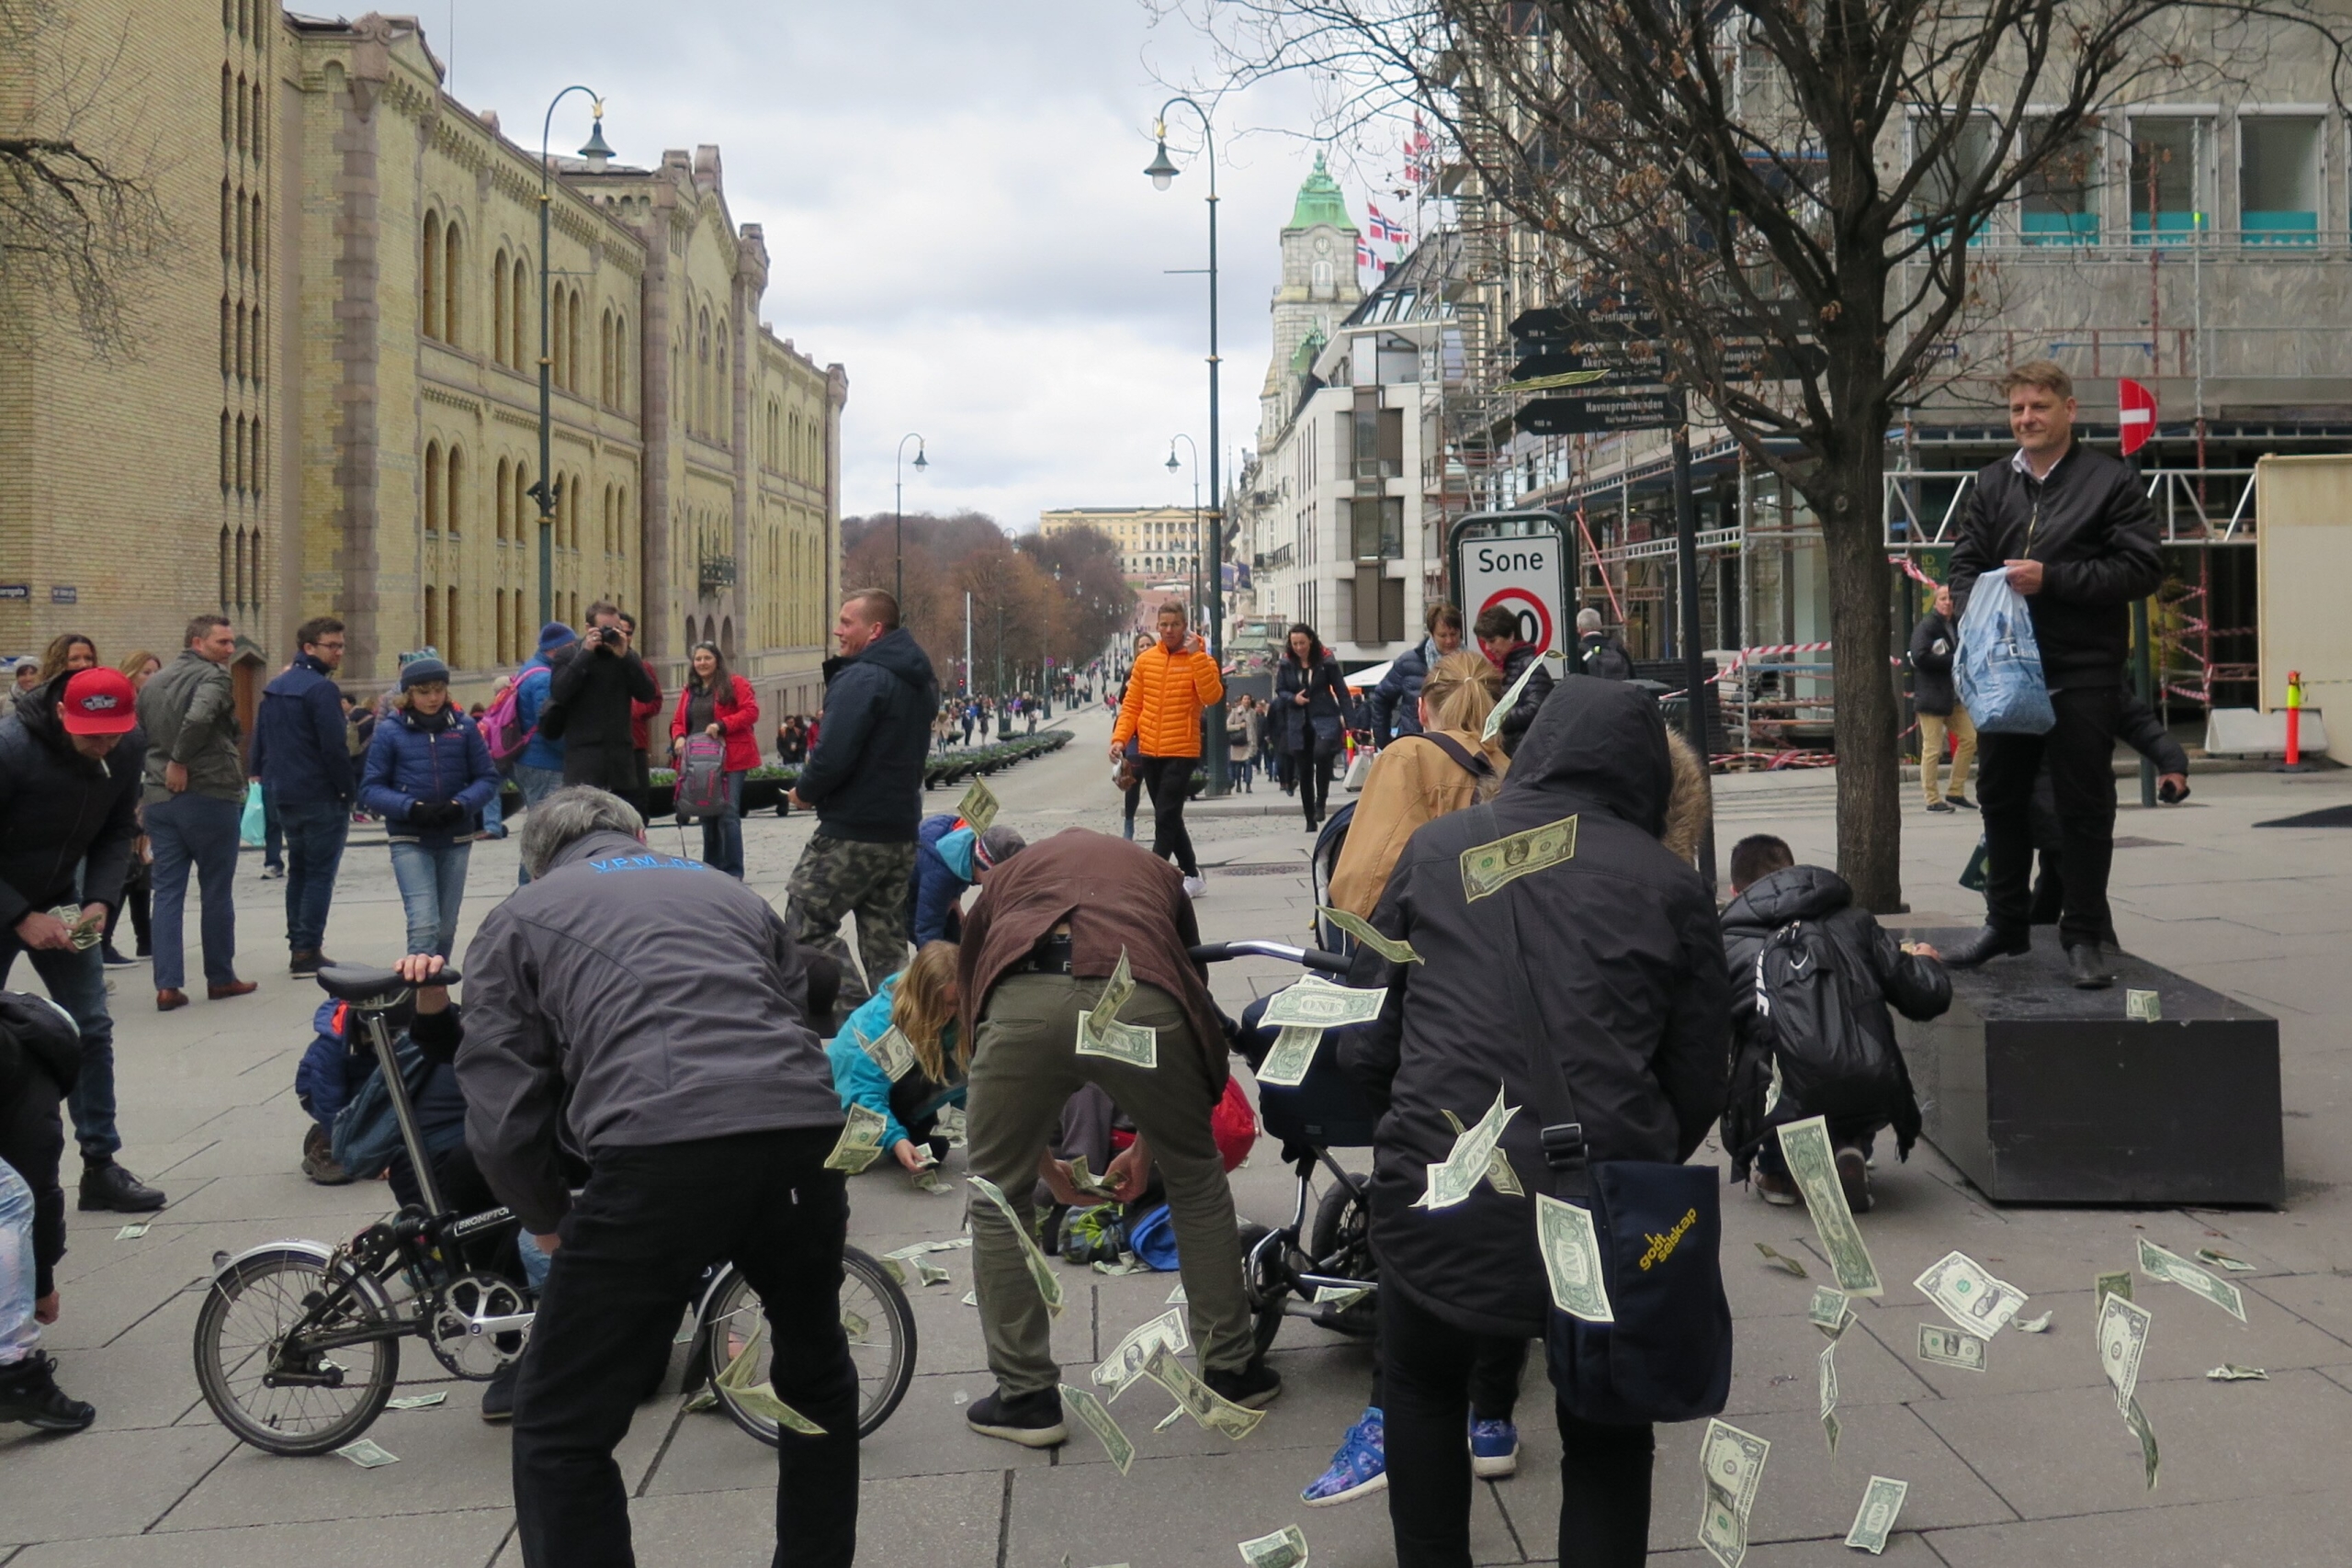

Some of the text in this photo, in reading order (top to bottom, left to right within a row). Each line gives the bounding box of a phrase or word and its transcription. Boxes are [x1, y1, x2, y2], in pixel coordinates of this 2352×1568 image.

[1478, 547, 1544, 572] Sone
[589, 855, 659, 871] VPM
[1302, 999, 1343, 1011] ONE
[1657, 1208, 1697, 1262] selskap
[1640, 1233, 1668, 1270] godt
